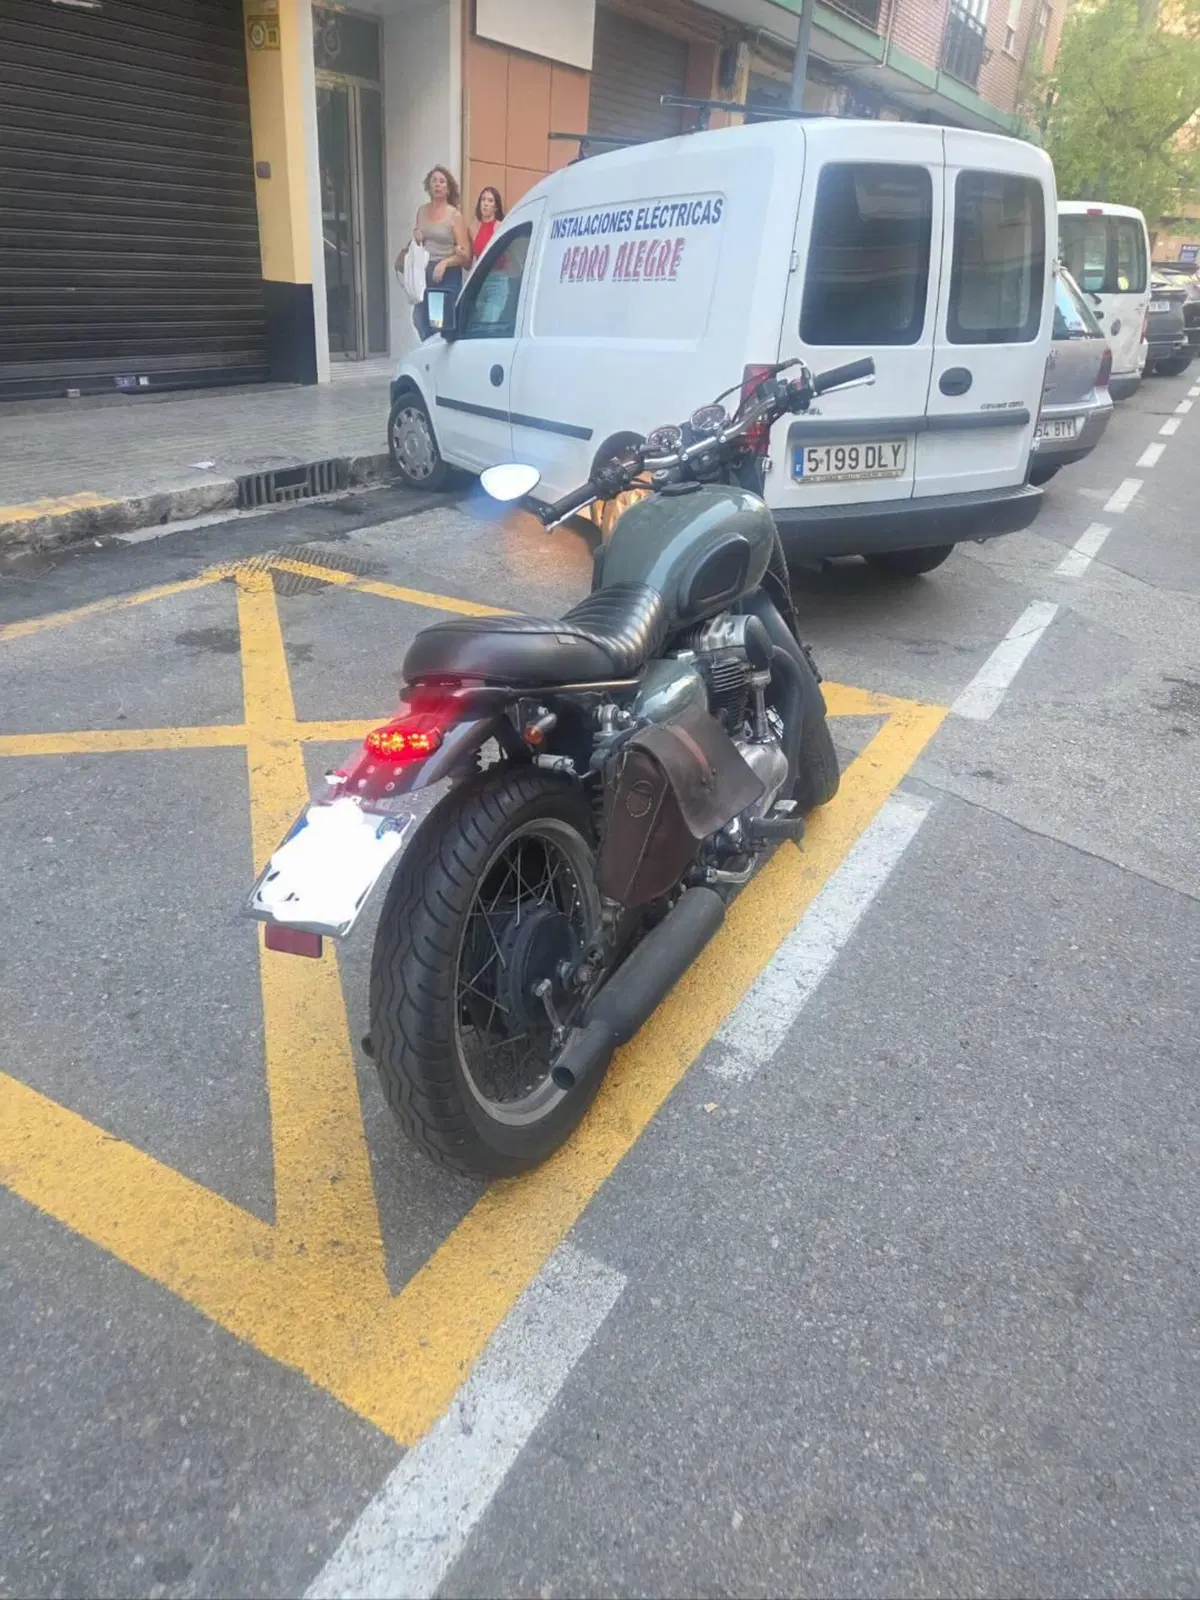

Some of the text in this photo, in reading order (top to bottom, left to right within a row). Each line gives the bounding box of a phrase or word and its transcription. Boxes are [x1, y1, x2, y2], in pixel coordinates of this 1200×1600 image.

[550, 198, 723, 240] INSTALACIONES ELÉCTRICAS
[559, 237, 686, 283] PEDRO ALEGRE
[1054, 420, 1073, 437] BTY
[807, 443, 903, 473] 5199 DLY
